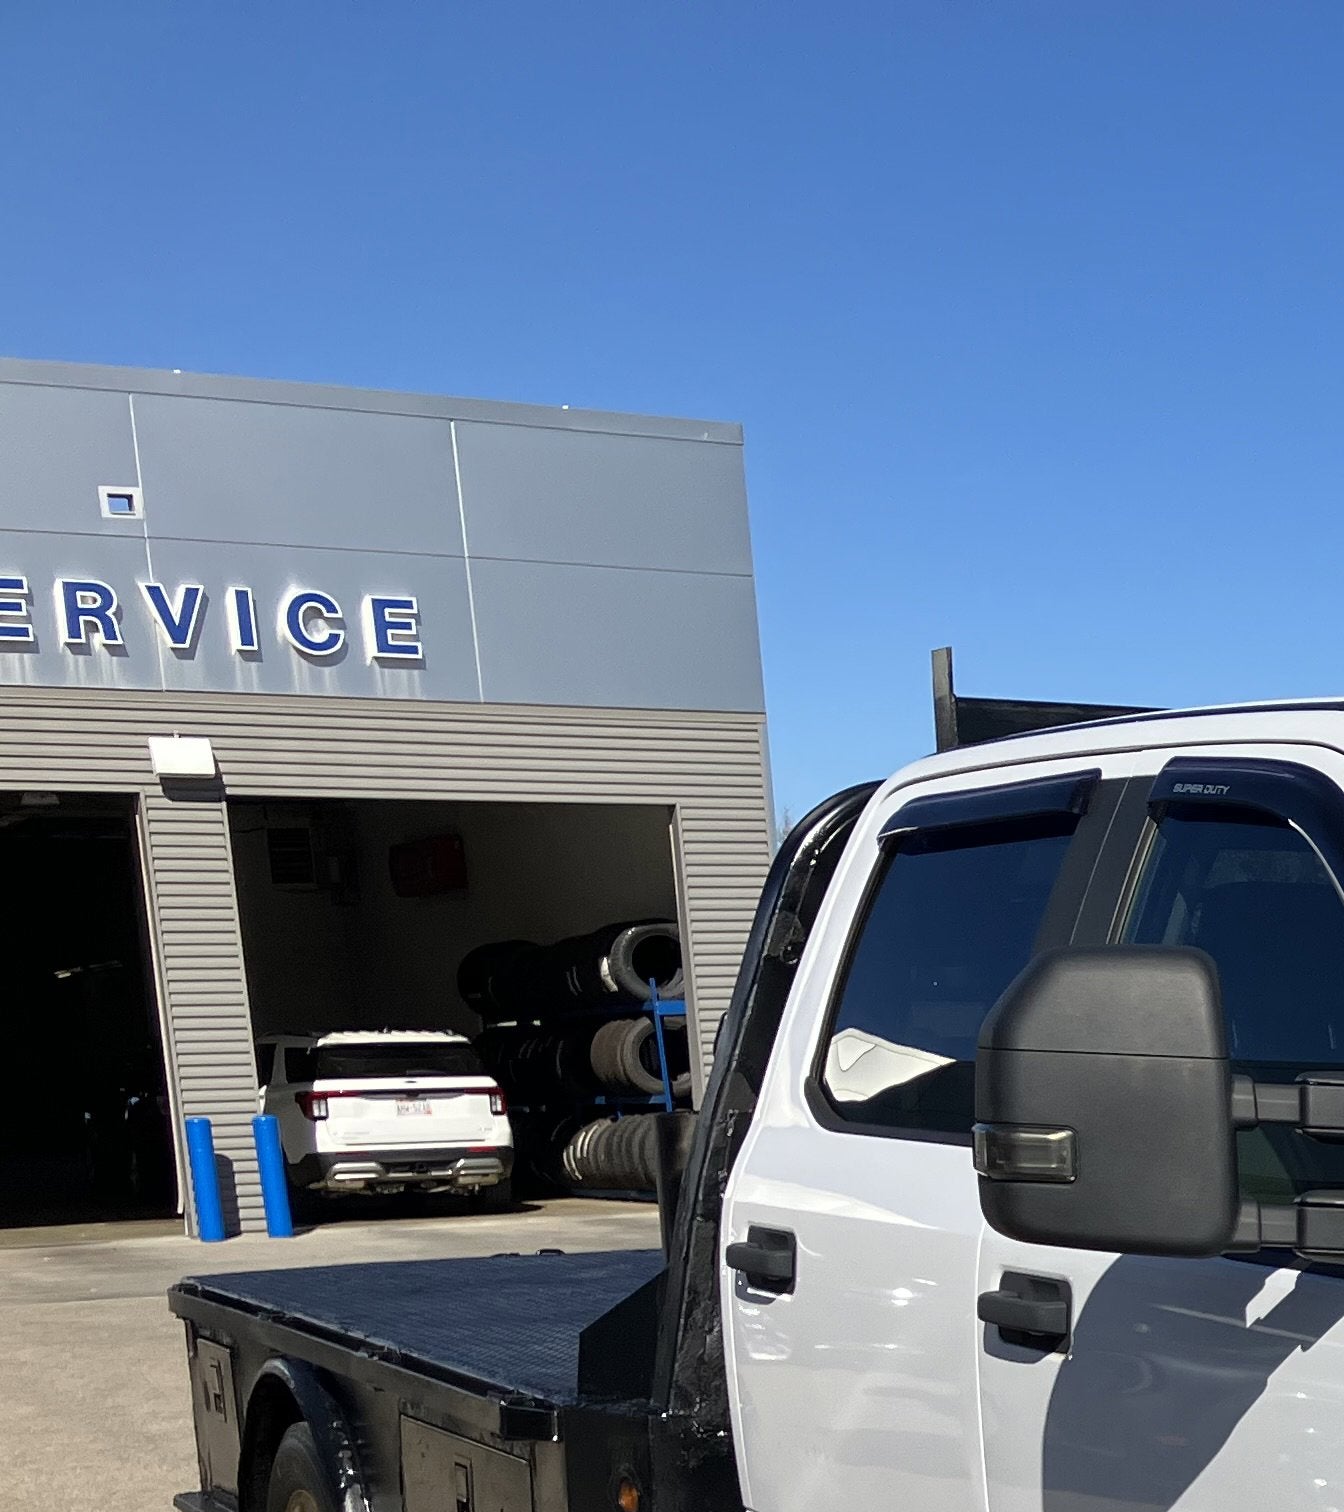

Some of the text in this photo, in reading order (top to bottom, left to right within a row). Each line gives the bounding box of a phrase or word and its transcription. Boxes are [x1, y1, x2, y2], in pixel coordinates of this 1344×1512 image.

[0, 576, 424, 660] ERVICE
[1173, 783, 1230, 794] SUPER DUTY
